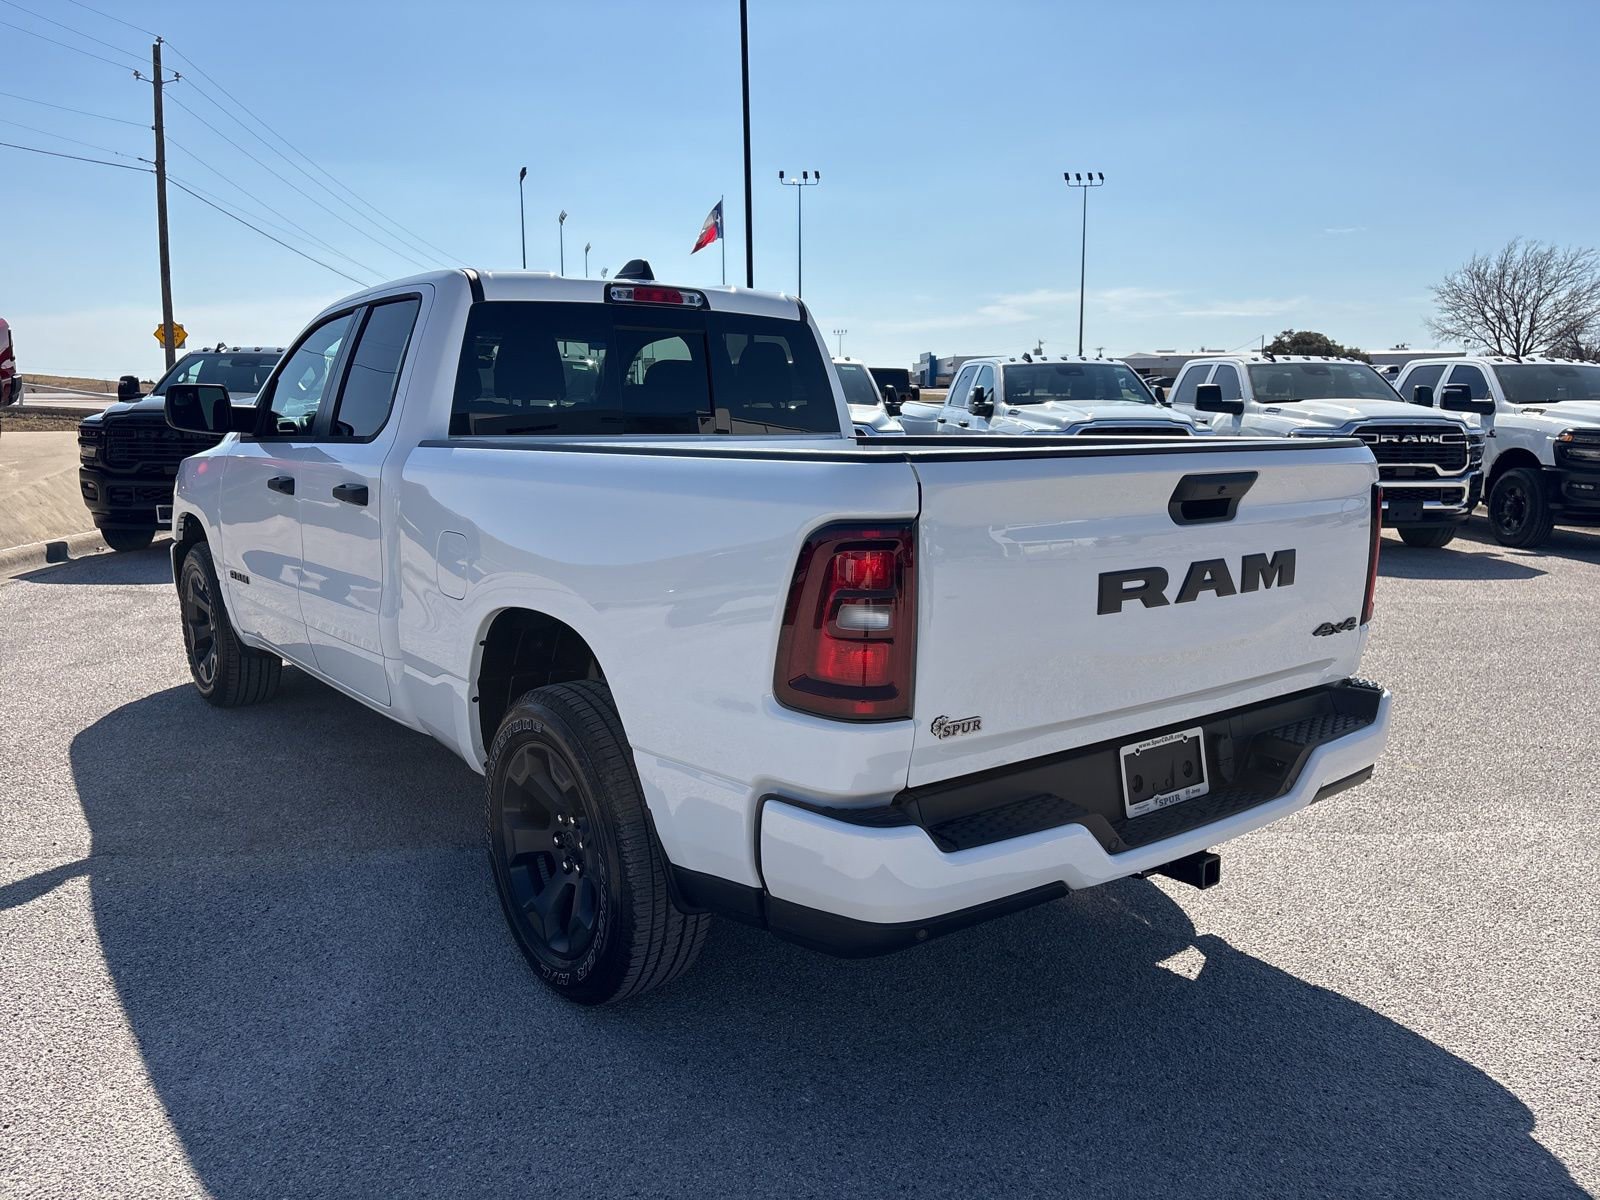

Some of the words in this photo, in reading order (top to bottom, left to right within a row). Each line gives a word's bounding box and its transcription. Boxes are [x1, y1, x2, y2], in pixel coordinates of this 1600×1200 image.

[1380, 434, 1440, 443] RAM
[1097, 548, 1297, 615] RAM
[943, 719, 982, 737] SPUR
[1158, 794, 1181, 807] SPUR
